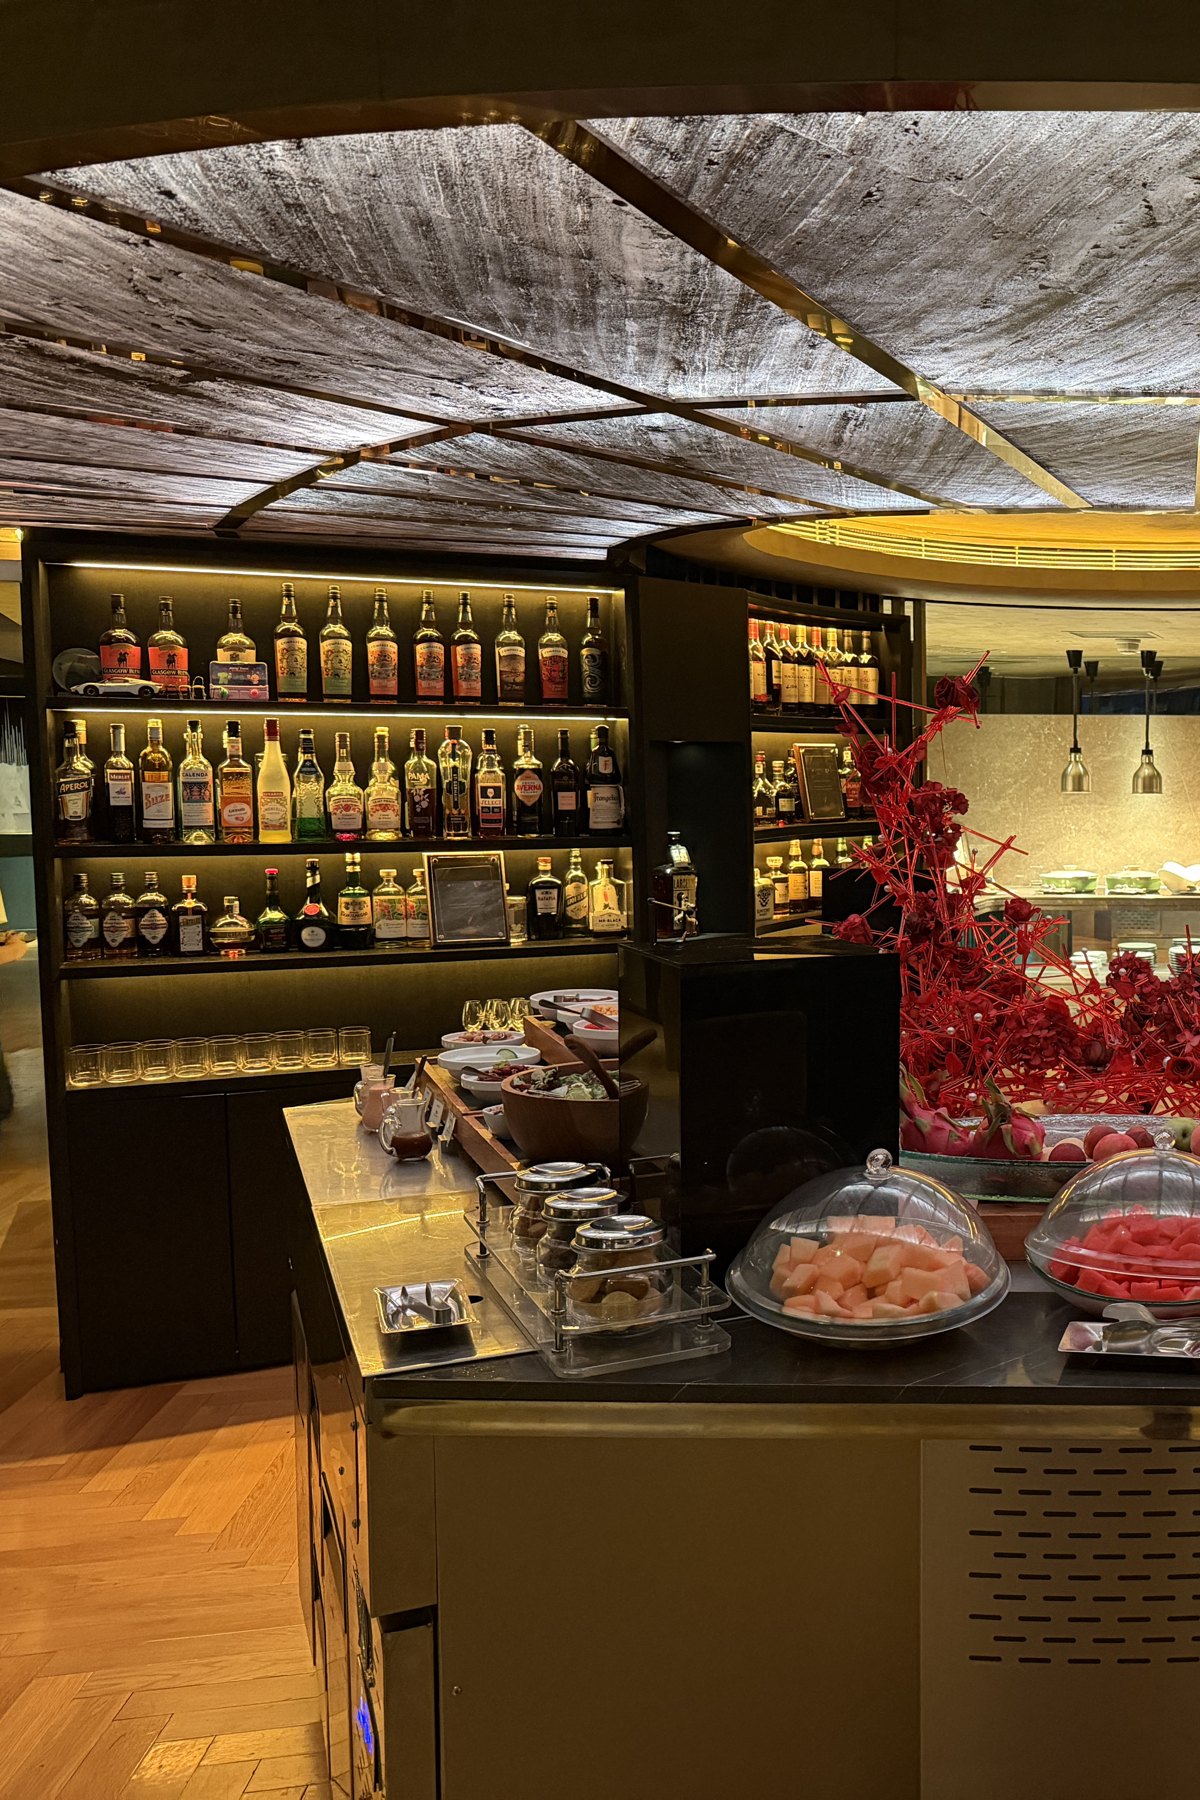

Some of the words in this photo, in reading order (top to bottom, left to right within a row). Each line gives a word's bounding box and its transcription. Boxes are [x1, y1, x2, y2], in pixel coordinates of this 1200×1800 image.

[408, 772, 431, 780] PAMA
[61, 782, 90, 793] APEROL
[145, 793, 170, 810] SUZE
